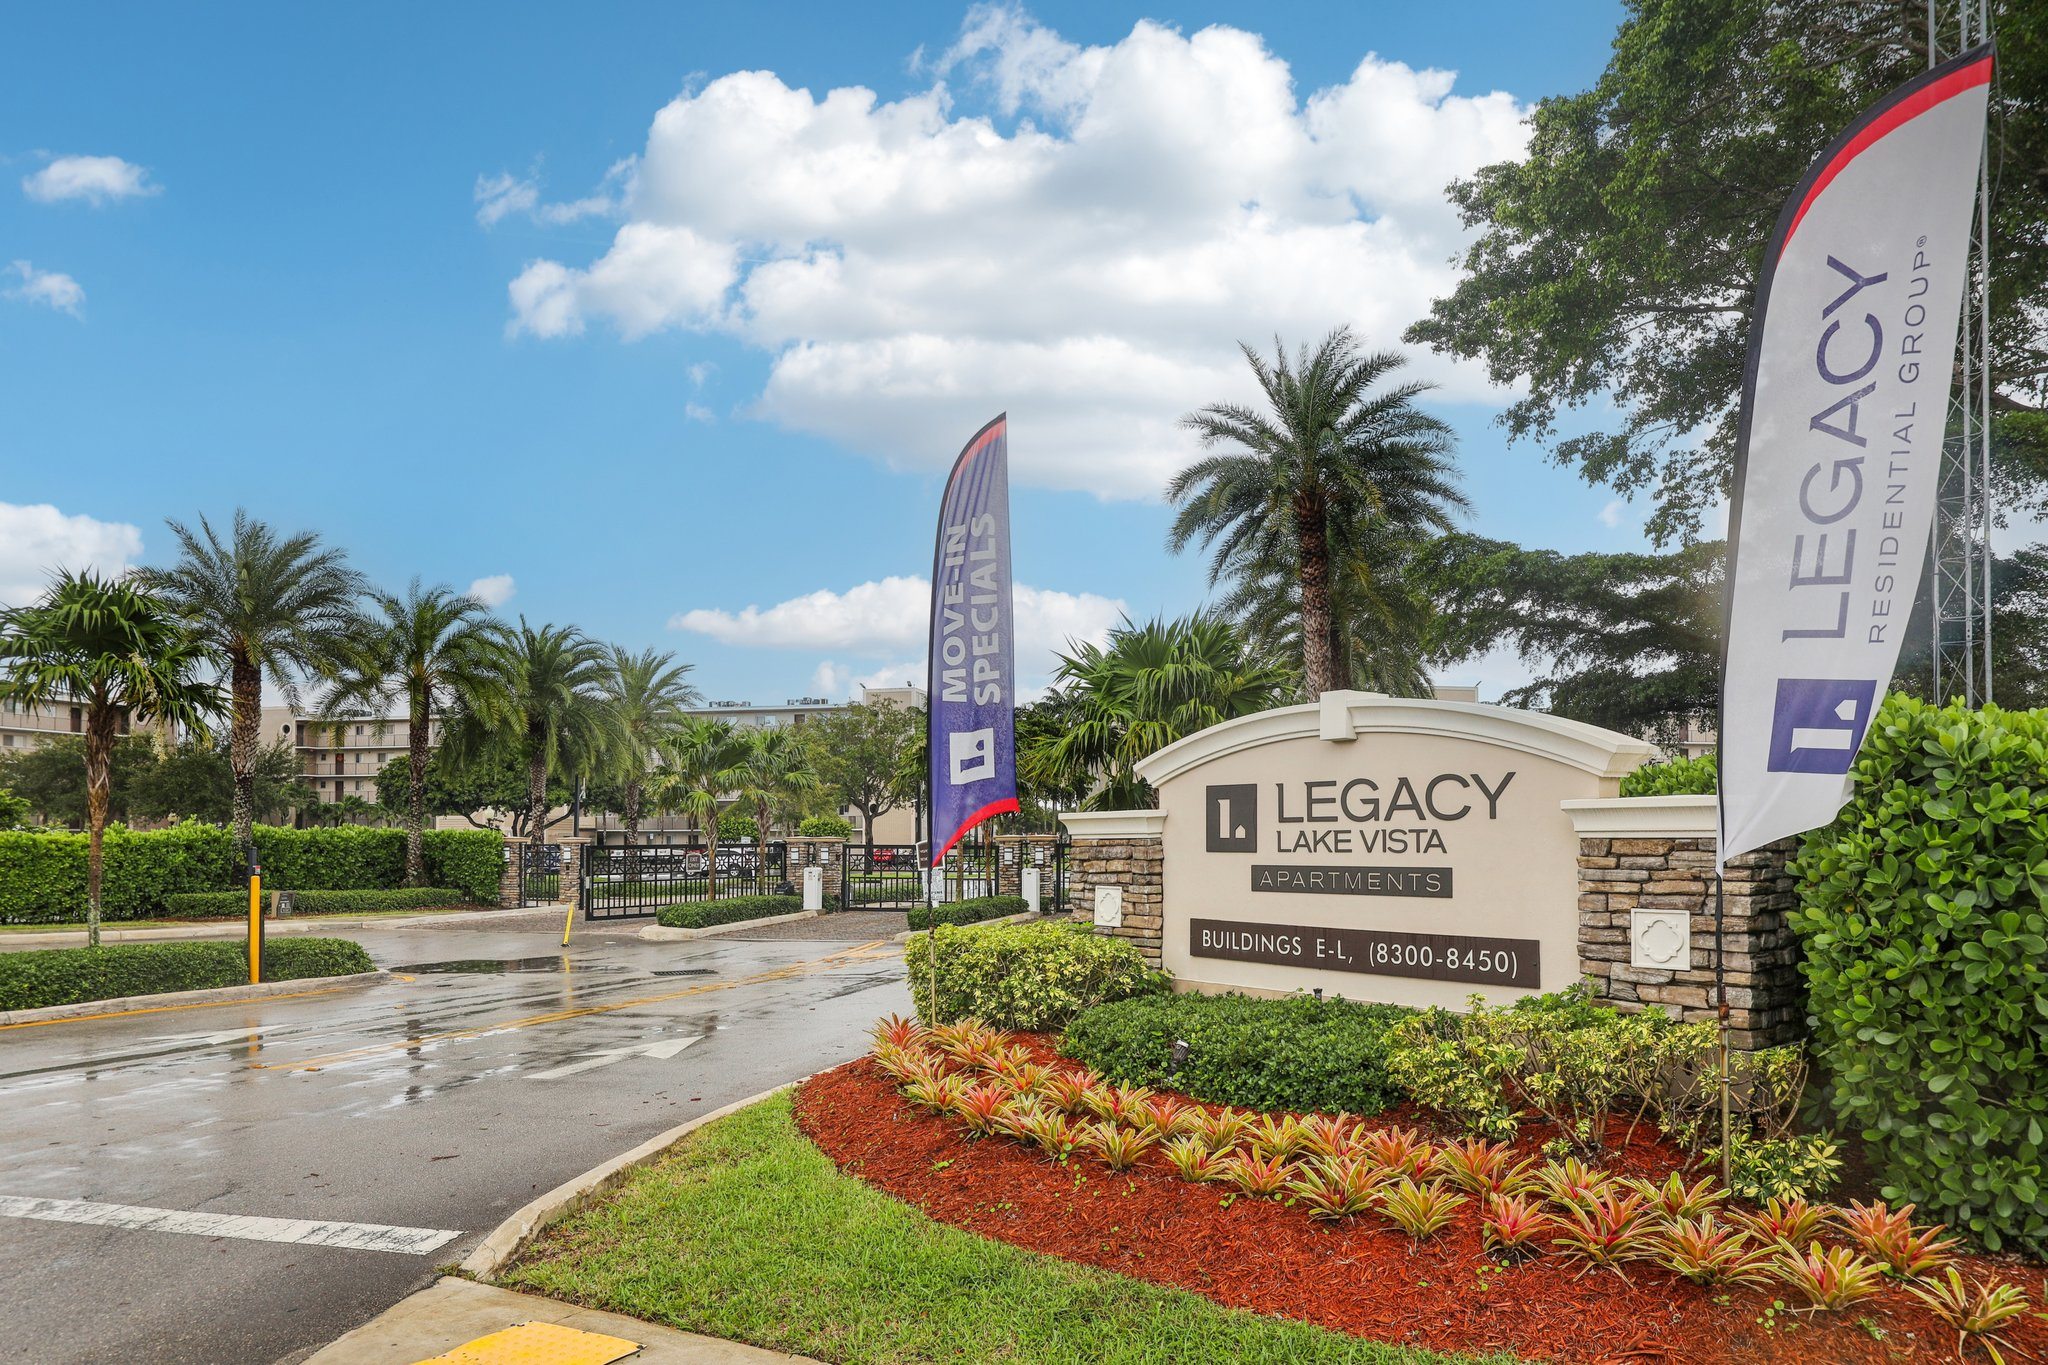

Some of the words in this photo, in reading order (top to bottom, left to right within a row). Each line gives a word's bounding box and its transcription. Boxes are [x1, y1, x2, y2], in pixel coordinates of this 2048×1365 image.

[1781, 254, 1888, 643] LEGACY
[1868, 401, 1916, 645] RESIDENTIAL
[942, 525, 967, 703] MOVE-IN
[971, 513, 1000, 706] SPECIALS
[1276, 771, 1516, 823] LEGACY
[1277, 829, 1353, 853] LAKE
[1359, 828, 1448, 854] VISTA
[1259, 870, 1442, 893] APARTMENTS
[1201, 929, 1302, 957] BUILDINGS
[1315, 938, 1354, 965] E-L,
[1369, 941, 1518, 980] (8300-8450)
